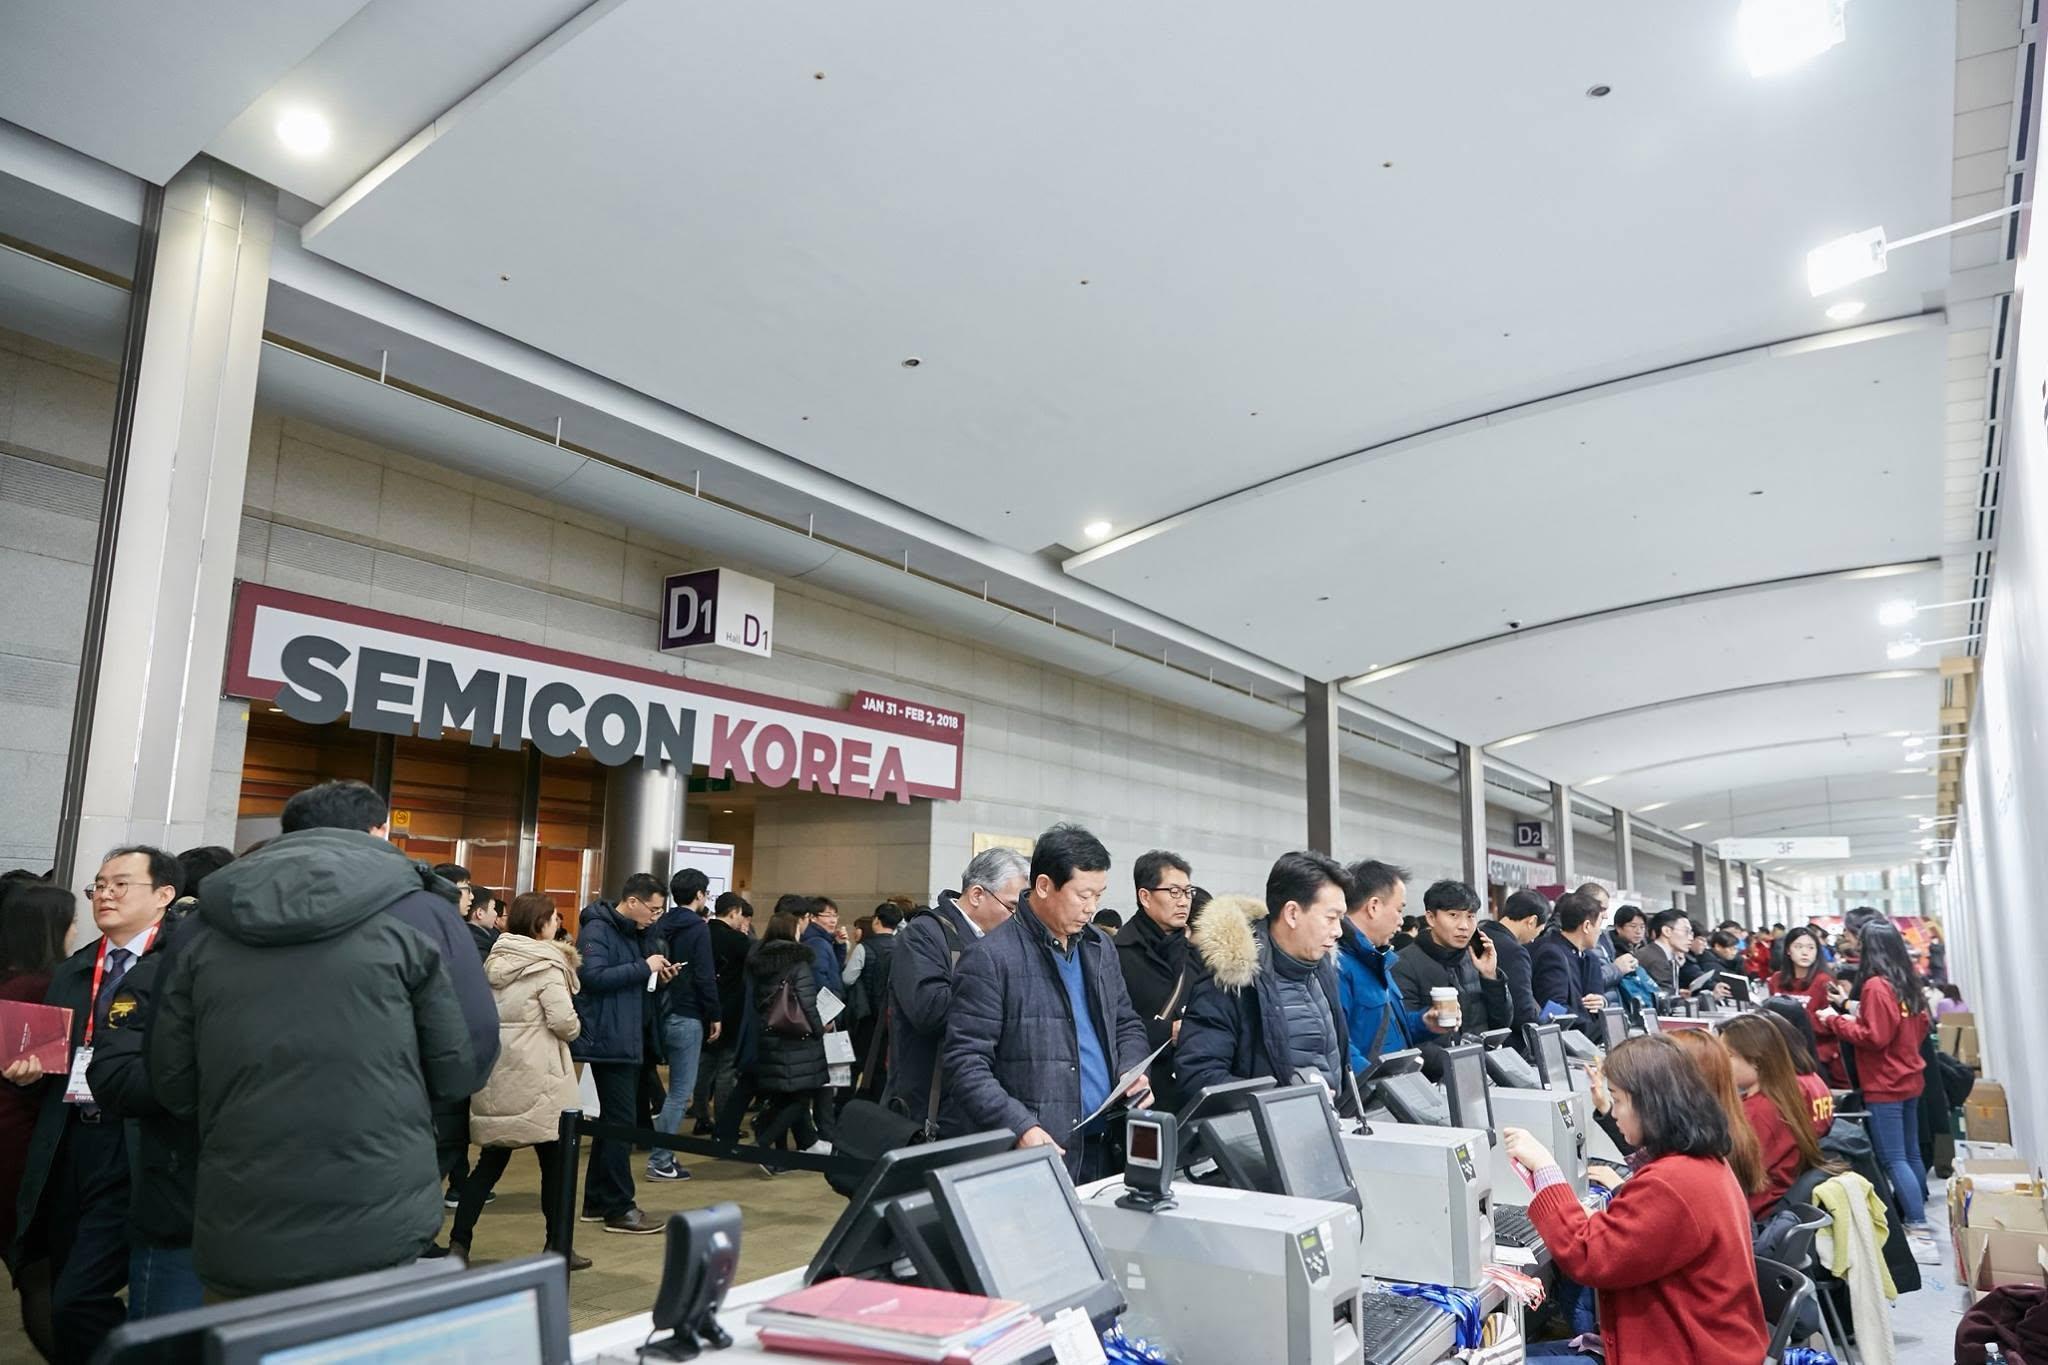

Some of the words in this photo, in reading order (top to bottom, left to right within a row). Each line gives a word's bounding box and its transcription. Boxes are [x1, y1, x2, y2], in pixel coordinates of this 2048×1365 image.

[668, 586, 712, 638] D1
[726, 632, 741, 645] Hall
[744, 614, 768, 650] D1
[274, 635, 697, 775] SEMICON
[708, 714, 910, 804] KOREA
[862, 697, 884, 714] JAN
[886, 702, 897, 716] 31
[905, 706, 924, 722] FEB
[926, 711, 935, 726] 2,
[936, 713, 958, 728] 2018
[1518, 826, 1541, 844] D2
[1777, 842, 1795, 854] 3F
